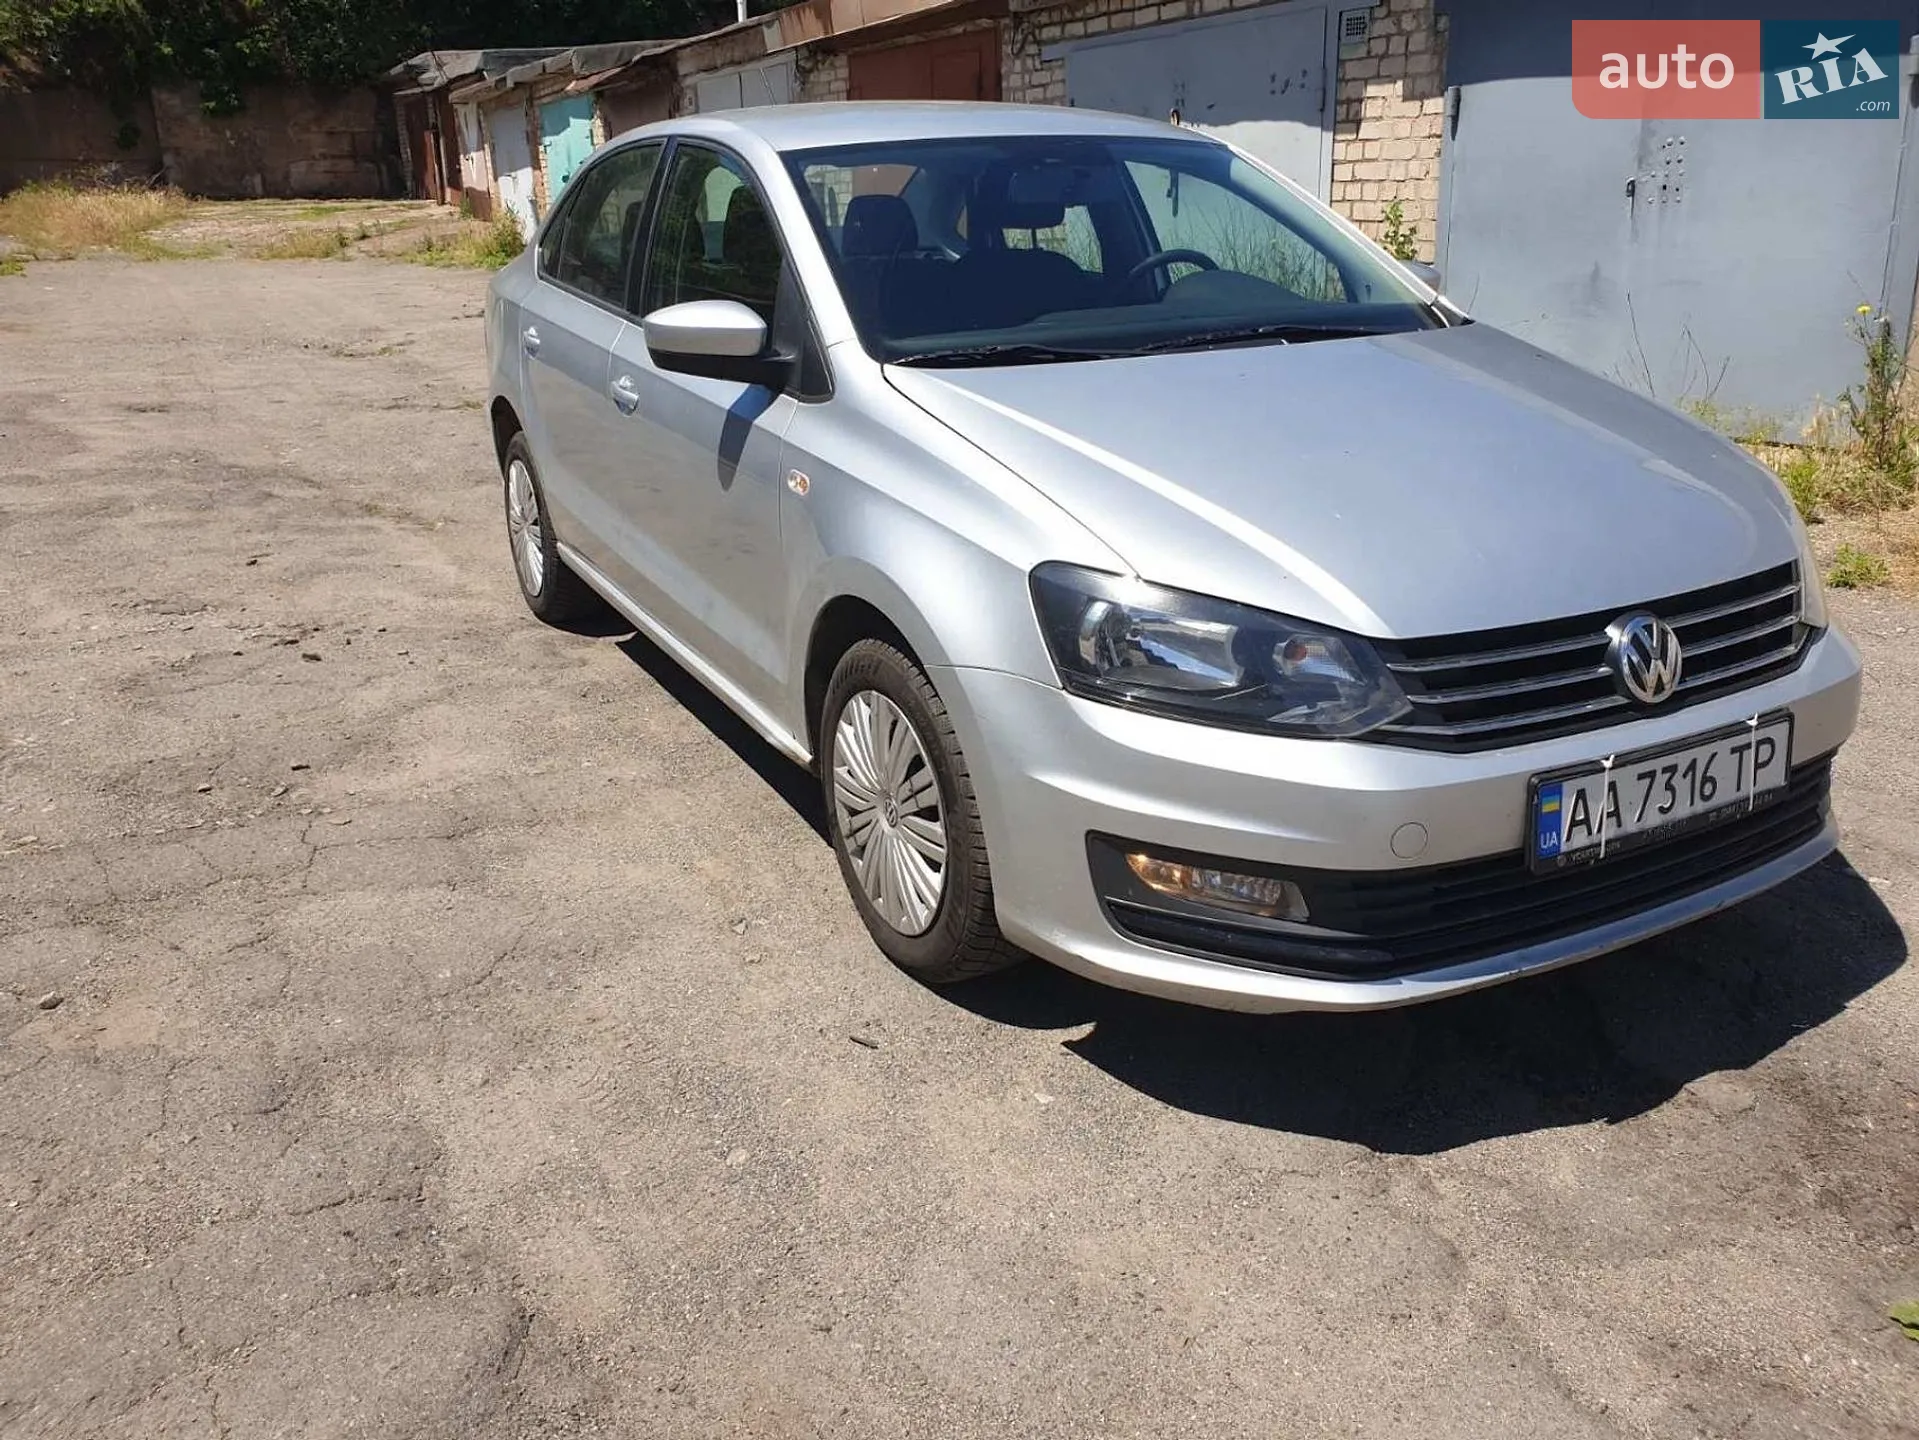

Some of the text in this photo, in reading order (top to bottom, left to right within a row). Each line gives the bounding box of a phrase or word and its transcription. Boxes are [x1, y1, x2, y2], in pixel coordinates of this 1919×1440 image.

[1564, 781, 1622, 842] AA
[1634, 752, 1718, 823] 7316
[1730, 737, 1776, 792] TP
[1540, 832, 1558, 849] UA
